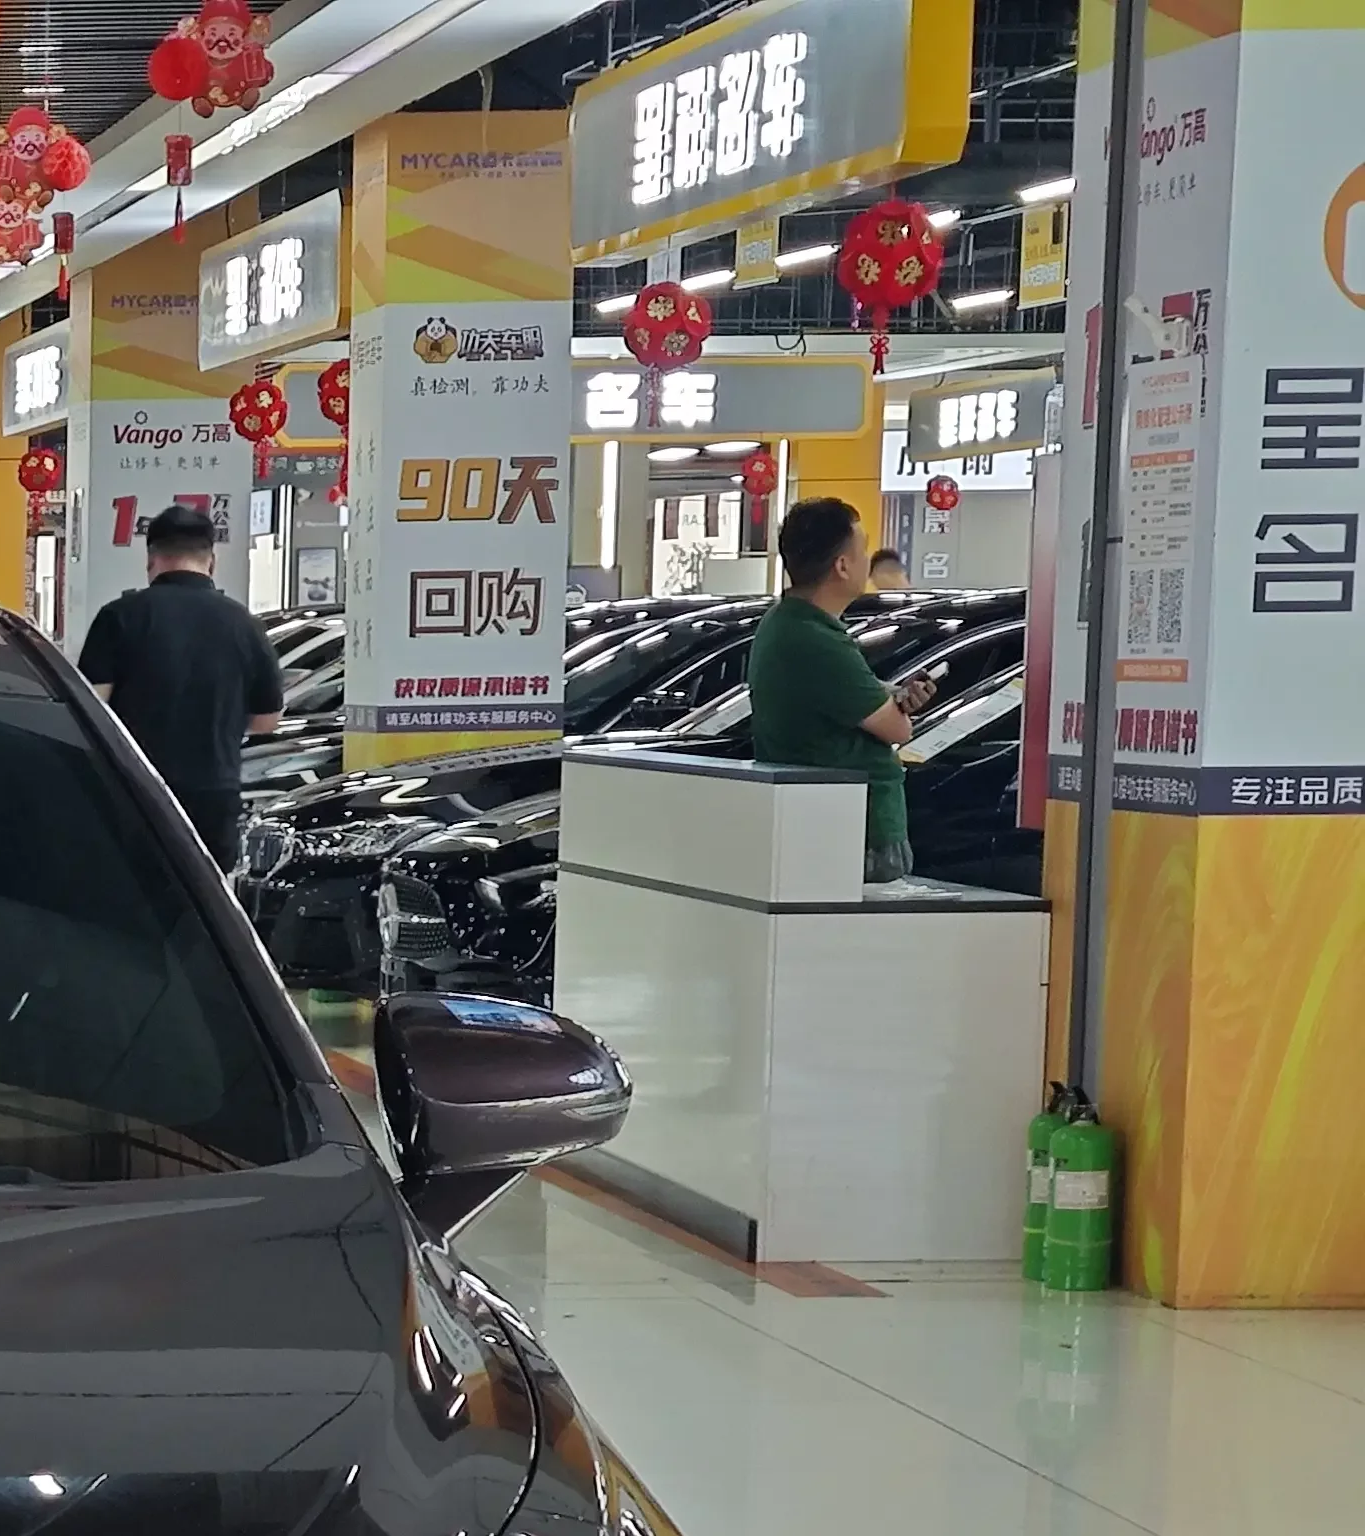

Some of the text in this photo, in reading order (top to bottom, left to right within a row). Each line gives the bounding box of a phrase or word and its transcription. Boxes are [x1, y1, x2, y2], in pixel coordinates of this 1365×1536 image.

[459, 326, 544, 361] 功夫车服
[586, 371, 717, 429] 名车
[112, 423, 231, 449] Vango 万高
[396, 456, 559, 524] 90天
[409, 567, 545, 638] 回购
[1230, 775, 1364, 806] 专注品质
